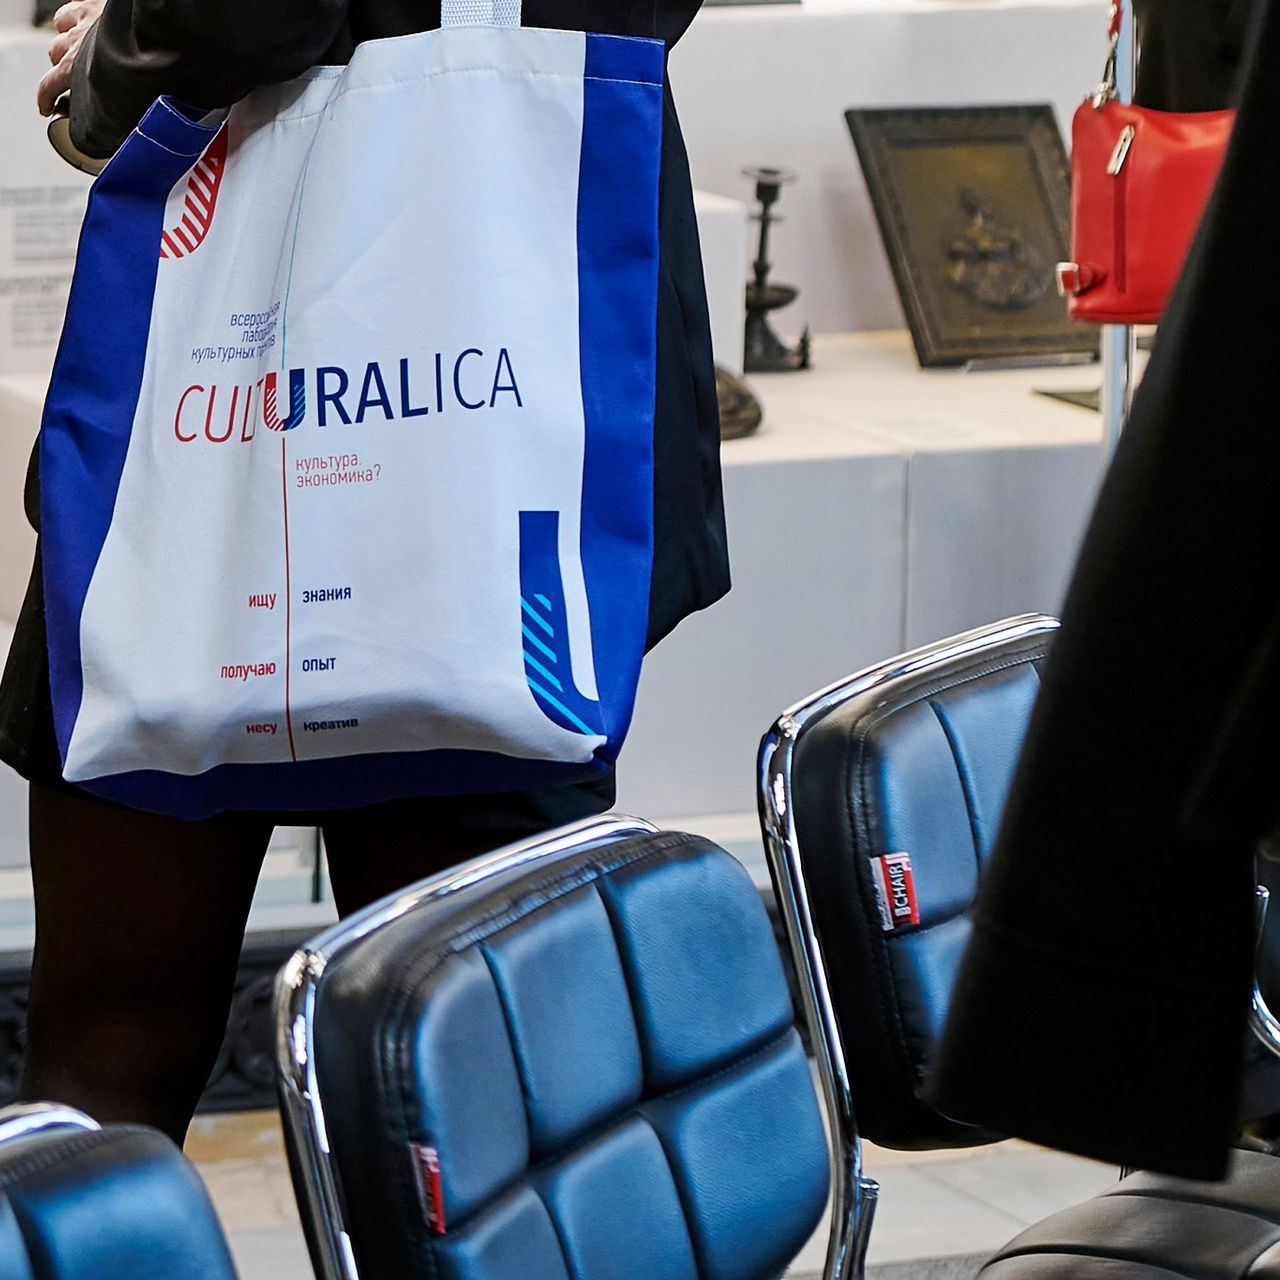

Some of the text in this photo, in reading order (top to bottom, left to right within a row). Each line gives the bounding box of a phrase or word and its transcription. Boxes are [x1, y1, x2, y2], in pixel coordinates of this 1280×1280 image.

[191, 345, 256, 363] культурных
[174, 347, 523, 443] CULTURALICA
[296, 453, 362, 474] культура.
[297, 464, 381, 488] экономика?
[249, 587, 352, 610] ищу знания
[221, 657, 337, 681] получаю опыт
[246, 718, 359, 735] несу креатив
